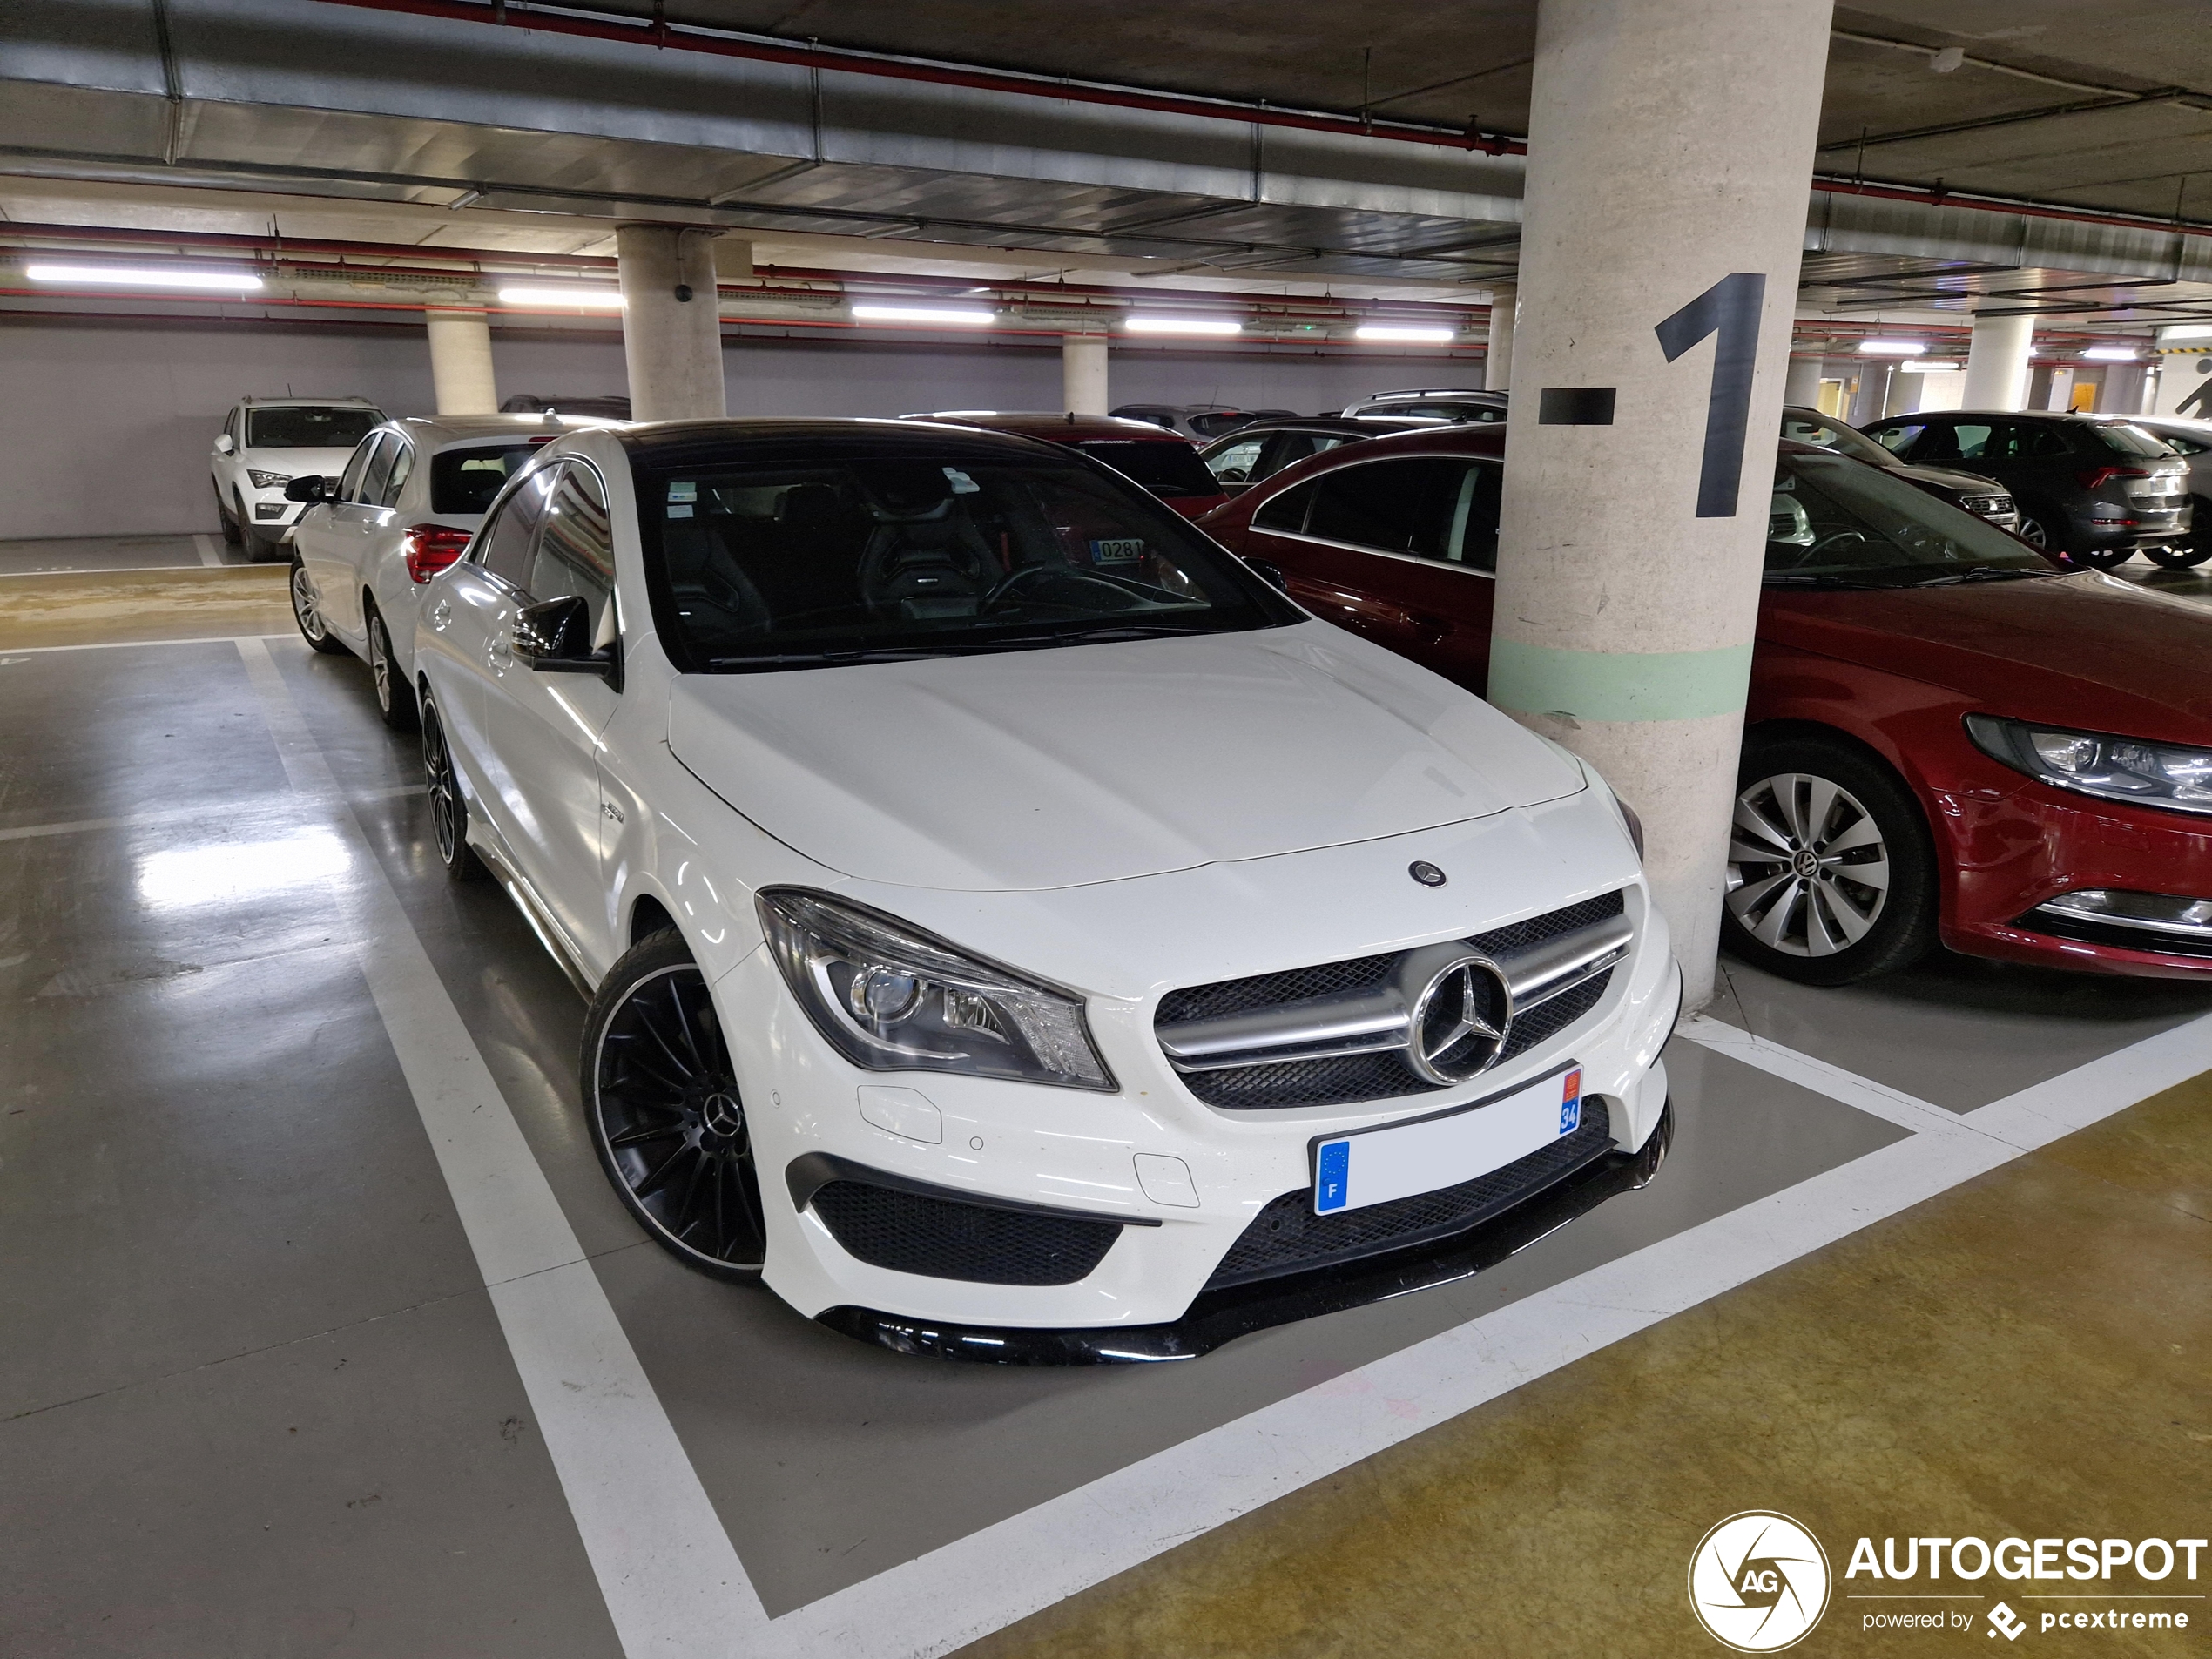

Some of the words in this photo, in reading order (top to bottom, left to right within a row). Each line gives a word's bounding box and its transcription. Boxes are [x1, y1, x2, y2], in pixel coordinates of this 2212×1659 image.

[1102, 542, 1141, 557] 0281
[1561, 1104, 1575, 1130] 34
[1328, 1183, 1338, 1198] F
